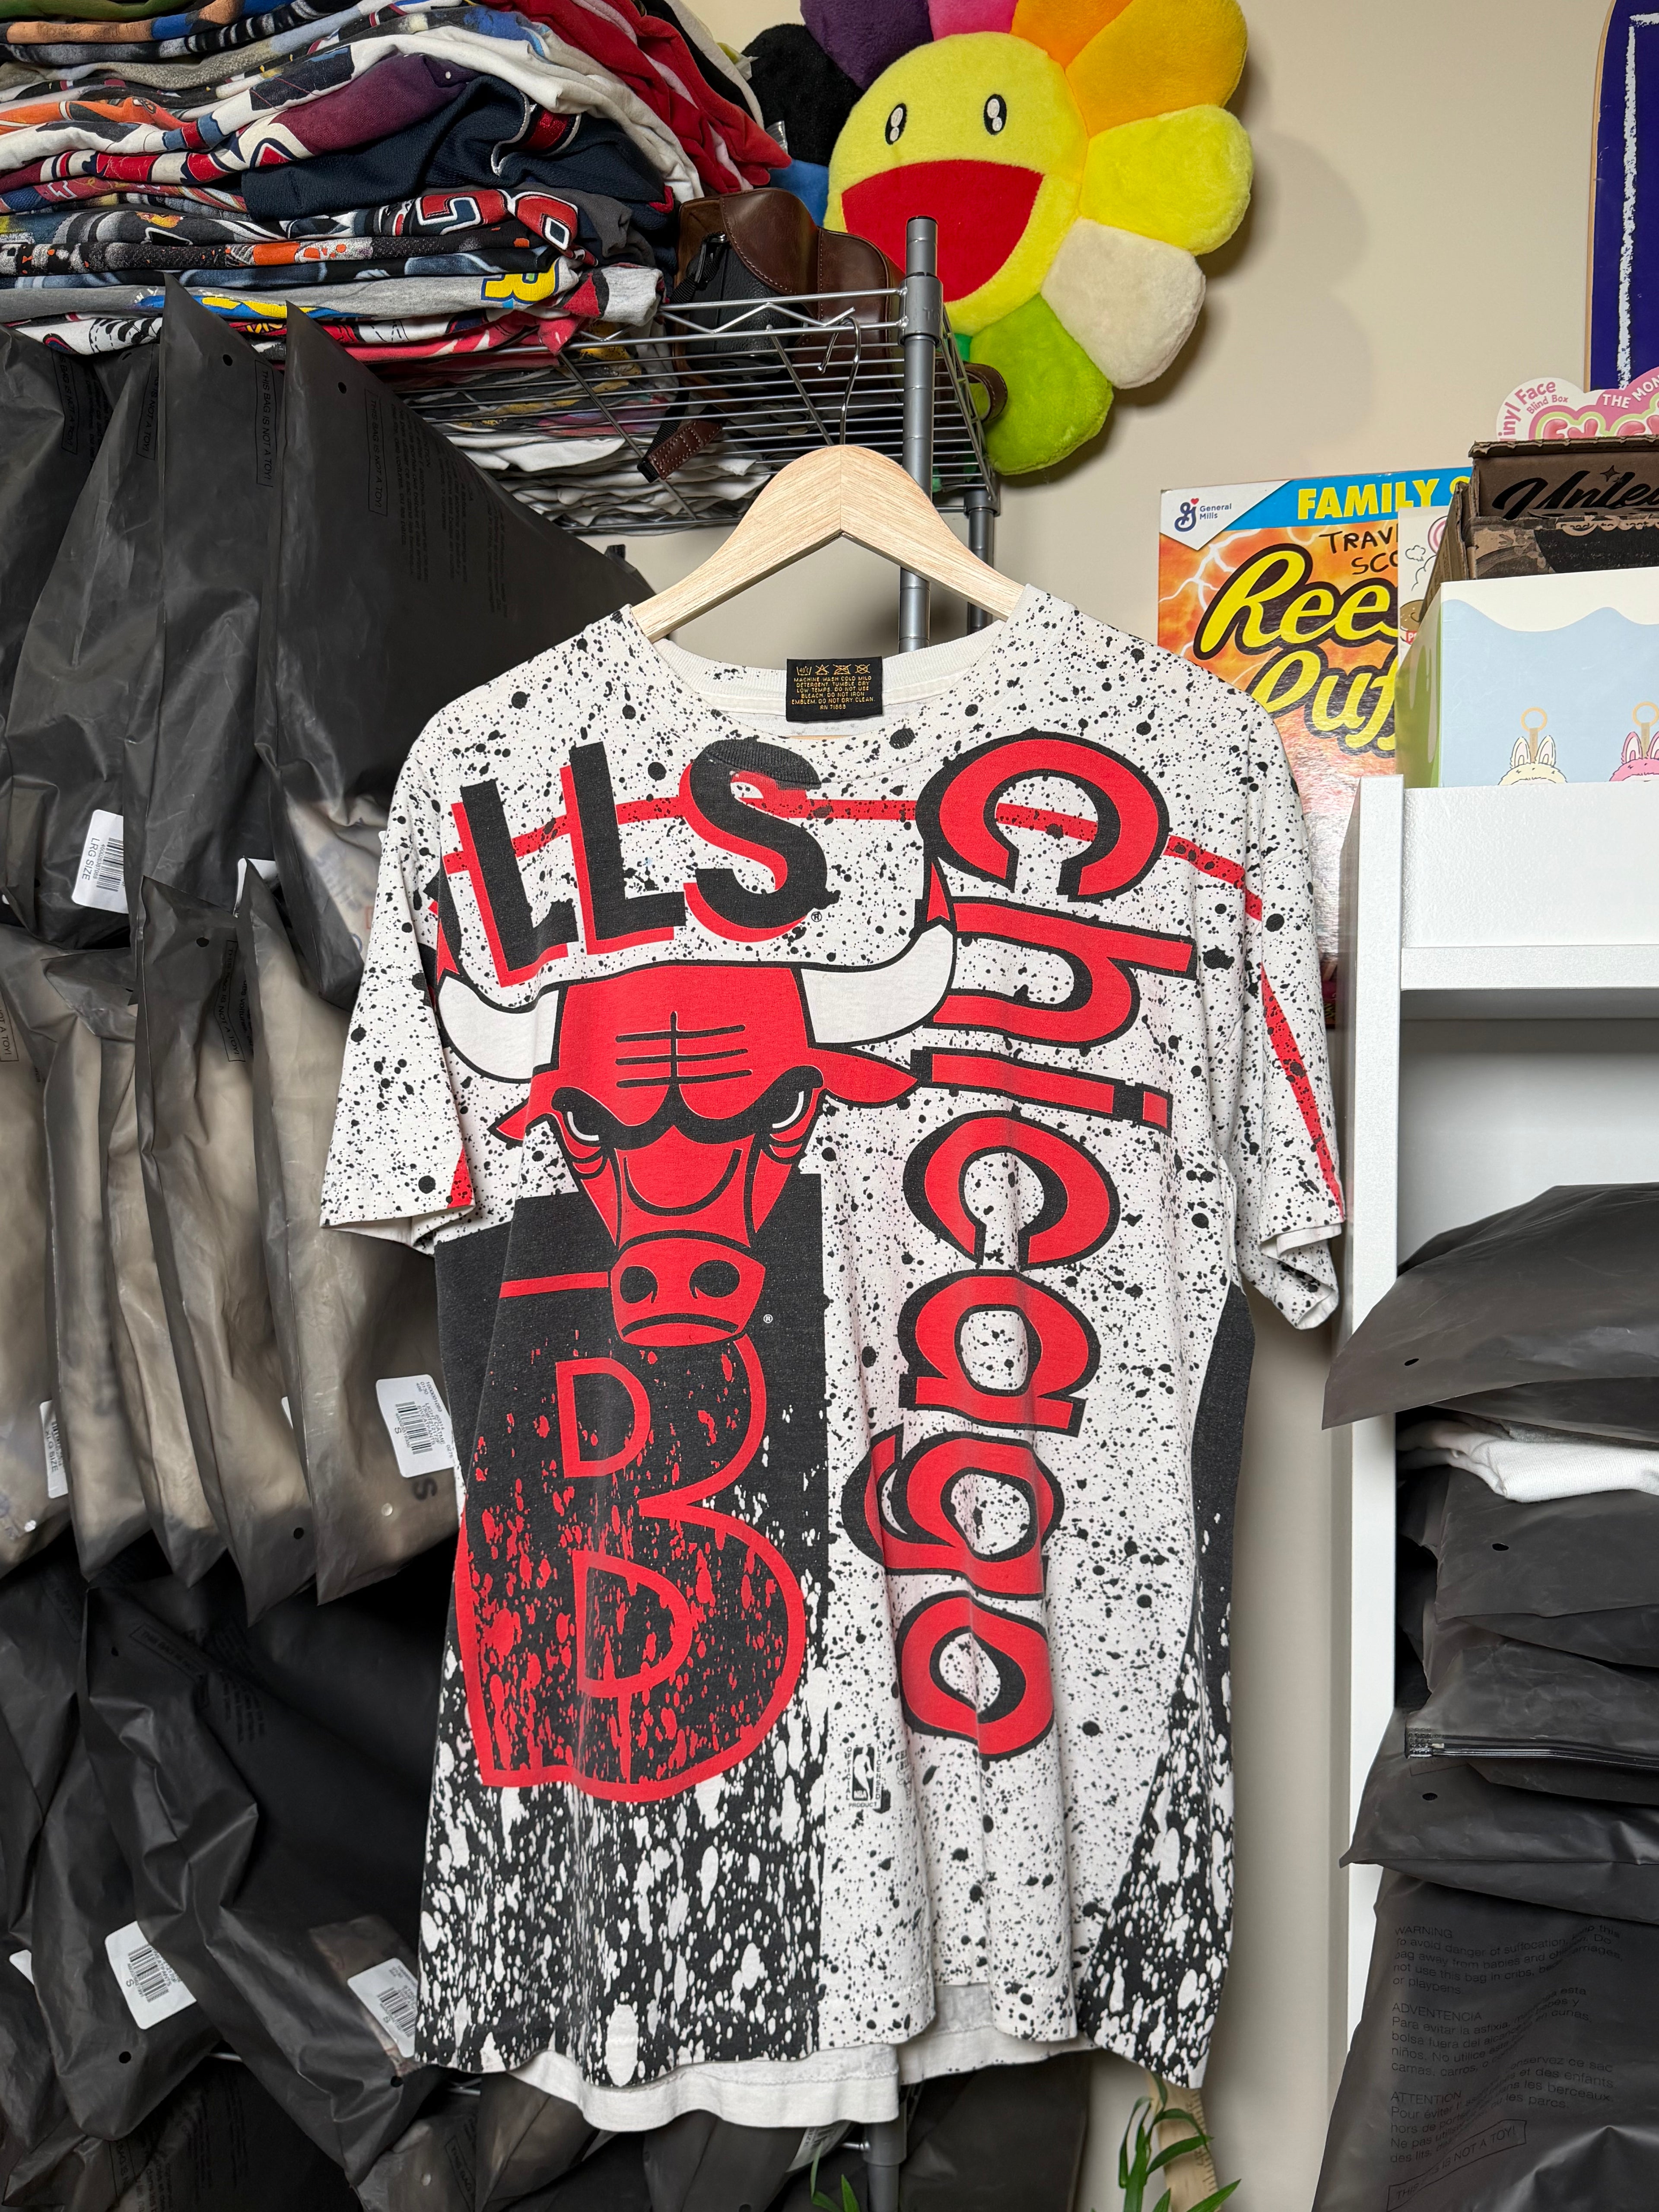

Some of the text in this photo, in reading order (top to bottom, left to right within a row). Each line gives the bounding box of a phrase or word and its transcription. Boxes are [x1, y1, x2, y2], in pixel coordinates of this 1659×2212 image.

[262, 372, 270, 390] THIS
[263, 393, 271, 413] BAG
[1498, 381, 1556, 441] inyl Face
[1526, 394, 1569, 414] Blind Box
[1602, 394, 1631, 409] THE
[262, 416, 270, 425] IS
[262, 428, 271, 447] NOT
[264, 459, 272, 480] TOY!
[1199, 503, 1232, 512] General
[1298, 478, 1440, 520] FAMILY
[1199, 512, 1218, 520] Mills
[1319, 523, 1398, 554] TRAVI
[1351, 550, 1398, 575] SCO
[1194, 543, 1398, 661] Ree
[1248, 647, 1397, 759] Puf
[82, 837, 100, 880] LRG SIZE
[219, 1005, 227, 1024] NOT
[840, 730, 1197, 1762] Chicago
[425, 1402, 435, 1420] LIGHT
[1395, 1926, 1453, 1939] WARNING
[1410, 1939, 1441, 1950] avoid
[1445, 1944, 1486, 1958] danger
[1490, 1947, 1500, 1956] of
[1419, 1952, 1449, 1967] away
[1452, 1958, 1479, 1969] from
[1483, 1957, 1520, 1970] babies
[1524, 1953, 1545, 1964] and
[1594, 1933, 1611, 1945] Do
[1393, 1963, 1411, 1973] not
[1415, 1965, 1437, 1977] use
[1440, 1969, 1461, 1982] this
[1465, 1973, 1487, 1984] bag
[1491, 1972, 1500, 1981] in
[1393, 1977, 1405, 1985] or
[1560, 1986, 1587, 1996] esta
[1392, 2002, 1482, 2022] ADVENTENCIA
[1392, 2016, 1419, 2030] Para
[1423, 2022, 1456, 2035] evitar
[1460, 2024, 1470, 2035] la
[1392, 2031, 1480, 2050] bolsa fuera del
[1392, 2046, 1427, 2061] niños.
[1432, 2052, 1449, 2063] No
[1454, 2050, 1485, 2063] utilice
[1390, 2090, 1462, 2105] ATTENTION
[1391, 2106, 1420, 2120] Pour
[1424, 2106, 1453, 2119] éviter
[1568, 2058, 1585, 2067] ce
[1589, 2061, 1614, 2073] sac
[1390, 2121, 1418, 2134] hors
[1421, 2123, 1437, 2133] de
[1519, 2067, 1531, 2077] et
[1535, 2067, 1560, 2079] des
[1390, 2079, 1543, 2150] Ne pas les
[1390, 2152, 1412, 2163] des
[1506, 2093, 1524, 2103] les
[1453, 2142, 1477, 2162] NOT
[1479, 2139, 1487, 2150] A
[1490, 2125, 1516, 2144] TOY!
